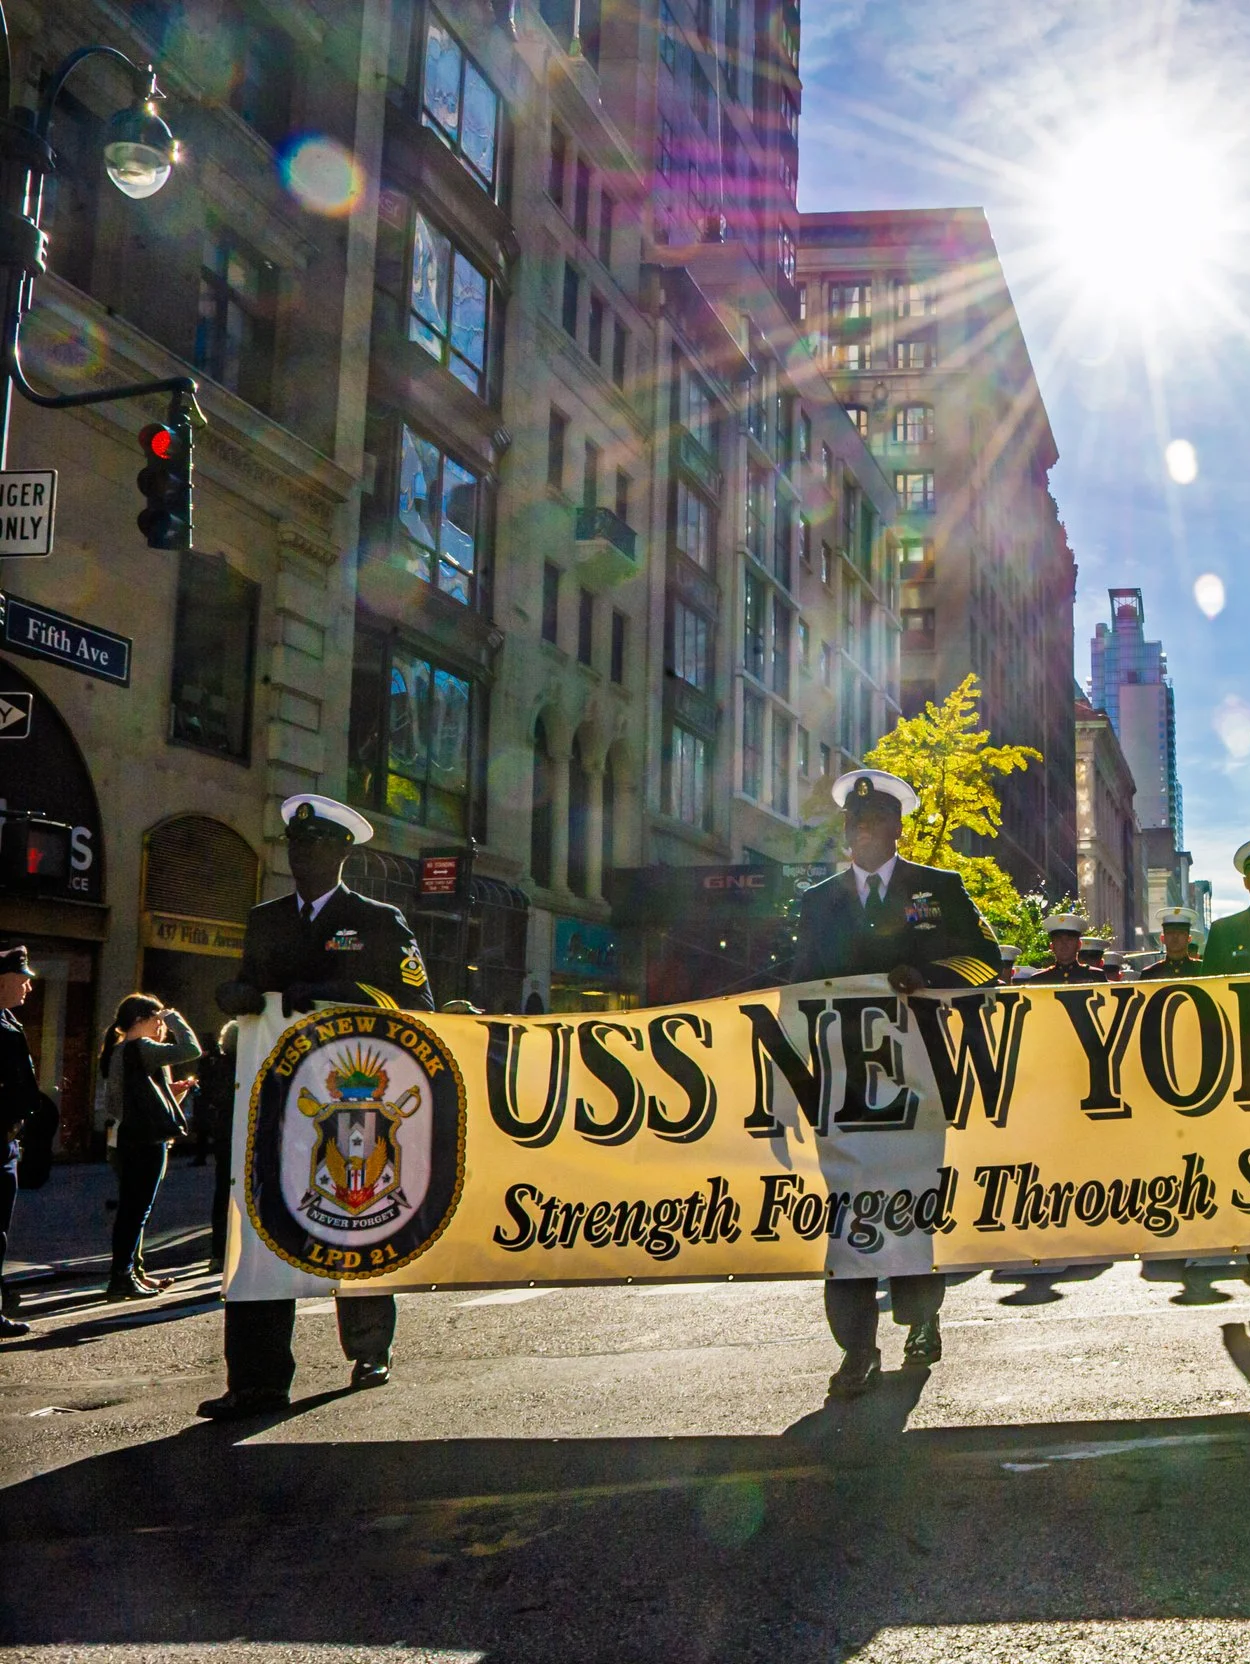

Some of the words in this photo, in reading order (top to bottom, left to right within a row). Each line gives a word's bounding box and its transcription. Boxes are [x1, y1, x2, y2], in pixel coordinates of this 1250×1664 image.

[0, 516, 43, 540] NLY
[27, 618, 71, 653] Fifth
[76, 637, 109, 666] Ave
[703, 874, 765, 889] GNC
[157, 922, 177, 941] 437
[180, 925, 209, 946] Fifth
[275, 1033, 313, 1078] USS
[318, 1016, 376, 1042] NEW
[386, 1021, 446, 1079] YORK
[478, 1012, 717, 1149] USS
[739, 992, 1031, 1138] NEW
[310, 1209, 350, 1228] NEVER
[352, 1208, 395, 1228] FORGET
[492, 1176, 740, 1261] Strength
[751, 1166, 958, 1253] Forged
[973, 1153, 1219, 1238] Through
[308, 1242, 361, 1268] LPD
[370, 1243, 398, 1267] 21
